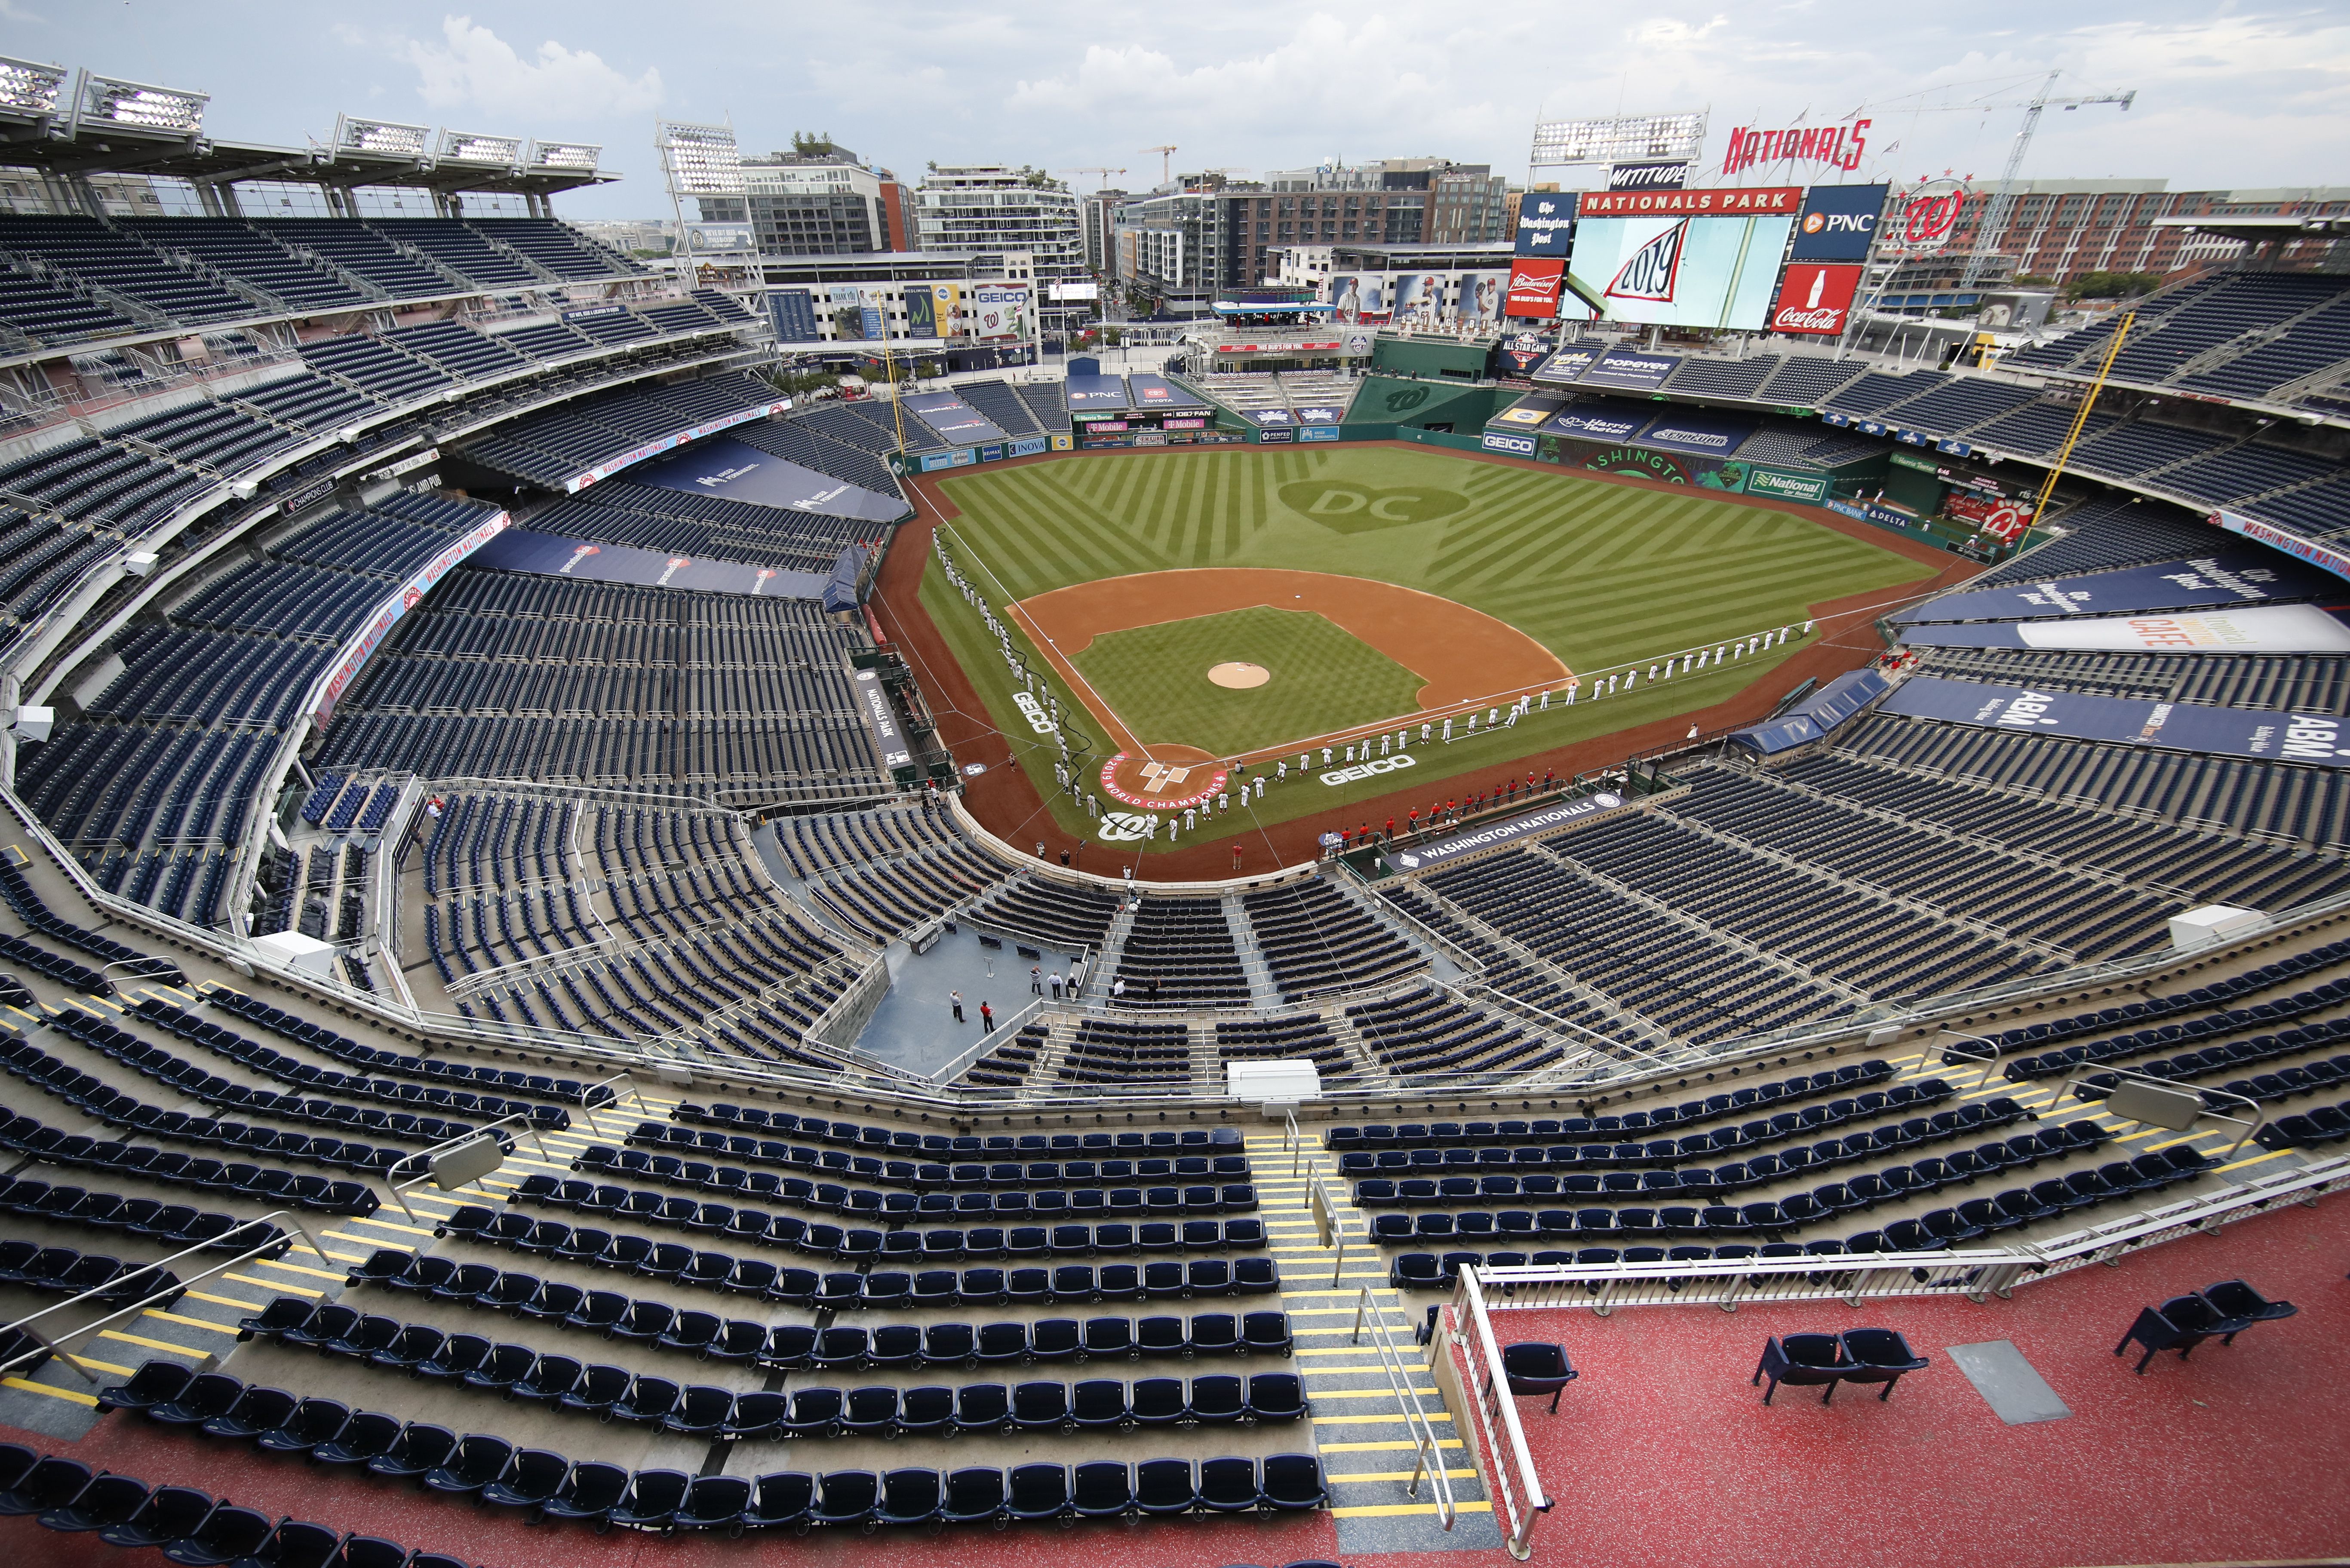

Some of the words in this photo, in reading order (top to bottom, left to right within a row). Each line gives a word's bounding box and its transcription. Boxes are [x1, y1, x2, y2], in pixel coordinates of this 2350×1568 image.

[1722, 119, 1872, 174] NATIONALS
[1610, 165, 1688, 187] NATITUDE
[1538, 202, 1555, 214] The
[1587, 195, 1712, 210] NATIONALS
[1723, 193, 1787, 208] PARK
[1520, 215, 1569, 230] Washington
[1826, 215, 1874, 232] PNC
[694, 234, 701, 243] DB
[1531, 233, 1551, 246] Post
[1621, 227, 1680, 294] 2019
[1514, 277, 1555, 288] Budweiser
[833, 292, 846, 301] THANK
[847, 292, 856, 300] YOU
[978, 292, 1028, 303] GEICO
[1503, 342, 1514, 350] ALL
[1515, 342, 1531, 352] STAR
[1531, 344, 1548, 353] GAME
[698, 419, 732, 435] WASHINGTON
[732, 409, 761, 426] NATIONALS
[1584, 425, 1627, 435] Teeter
[1588, 418, 1633, 430] Harris
[1017, 441, 1044, 452] INOVA
[1485, 435, 1533, 452] GEICO
[603, 452, 637, 475] WASHINGTON
[638, 440, 668, 460] NATIONALS
[929, 458, 948, 468] SELTZER
[1898, 455, 1917, 466] Harris
[1917, 461, 1935, 472] Teeter
[1937, 467, 1950, 476] 6:46
[430, 474, 442, 489] PUB
[1768, 477, 1819, 493] National
[294, 487, 322, 507] CHAMPIONS
[320, 481, 334, 493] CLUB
[1308, 490, 1422, 522] DC
[1834, 502, 1846, 512] PNC
[1846, 506, 1863, 519] BANK
[1877, 512, 1906, 527] DELTA
[2243, 521, 2313, 558] WASHINGTON
[424, 545, 464, 584] WASHINGTON
[462, 523, 495, 554] NATIONALS
[2185, 558, 2268, 598] Washington
[2035, 583, 2081, 613] Washington
[2127, 619, 2196, 647] CAFE
[2204, 616, 2258, 645] tropical
[326, 648, 367, 701] WASHINGTON
[366, 608, 395, 653] NATIONALS
[866, 688, 888, 721] NATIONALS
[879, 721, 895, 738] PARK
[1012, 691, 1055, 734] GEICO
[885, 753, 897, 766] MLB
[965, 766, 975, 775] MLB
[1101, 761, 1115, 782] 2019
[1319, 754, 1416, 786] GEICO
[1105, 782, 1140, 806] WORLD
[1154, 782, 1223, 809] CHAMPIONS
[1420, 823, 1508, 860] WASHINGTON
[1508, 801, 1596, 834] NATIONALS
